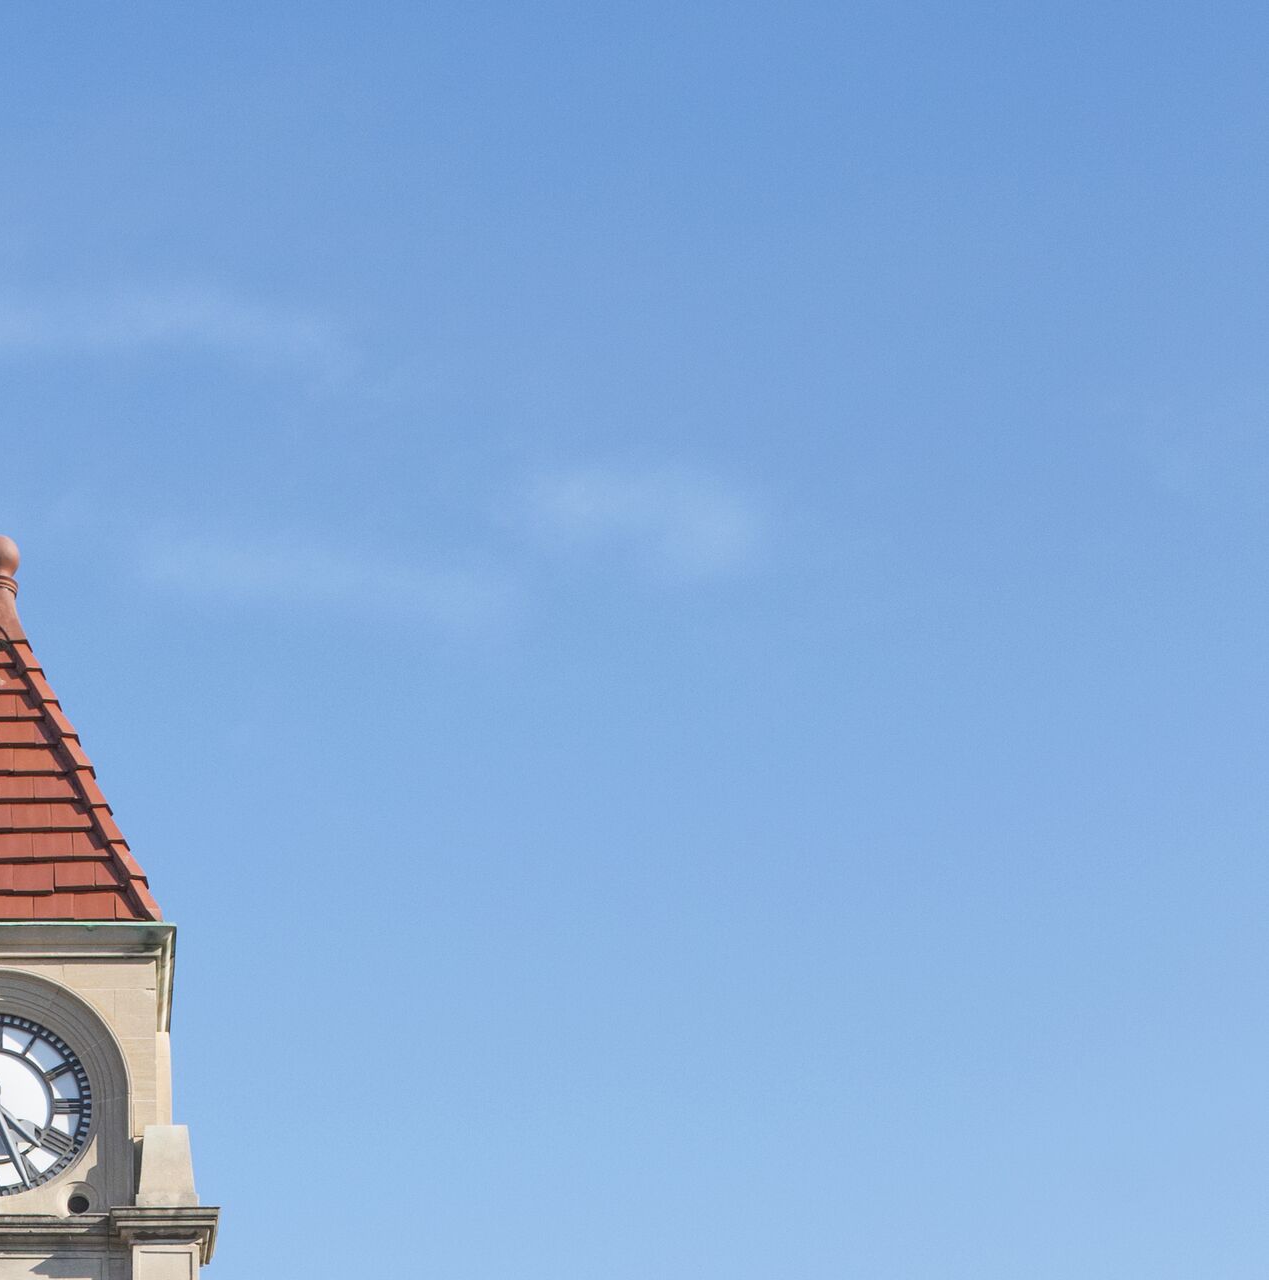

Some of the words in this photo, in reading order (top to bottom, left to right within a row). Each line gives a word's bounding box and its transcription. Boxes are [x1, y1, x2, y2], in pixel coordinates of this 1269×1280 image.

[22, 1034, 38, 1056] I
[44, 1060, 73, 1082] II
[53, 1098, 81, 1114] III
